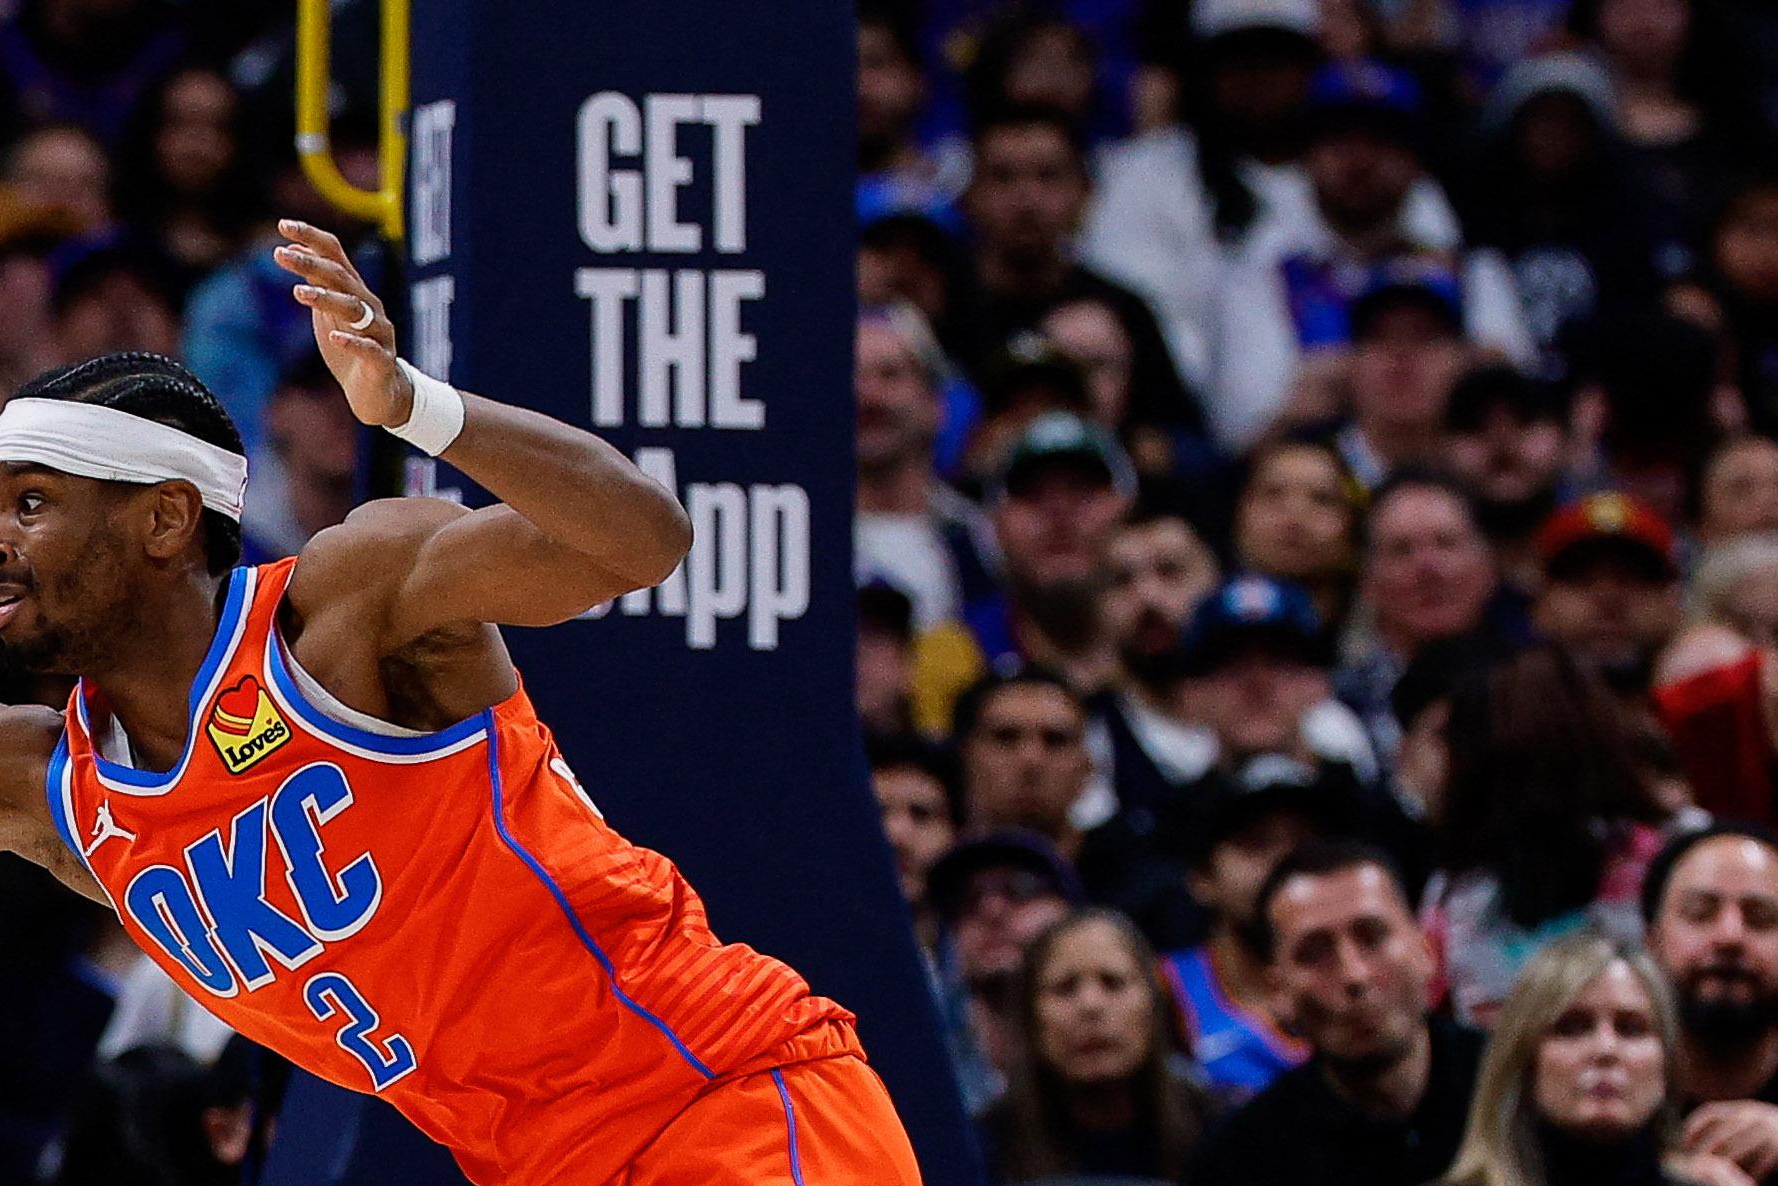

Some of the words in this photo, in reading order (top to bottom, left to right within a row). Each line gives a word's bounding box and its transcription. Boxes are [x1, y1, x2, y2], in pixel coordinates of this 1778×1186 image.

[576, 91, 762, 254] GET
[573, 268, 767, 430] THE
[123, 760, 383, 999] OKC
[302, 971, 418, 1092] 2
